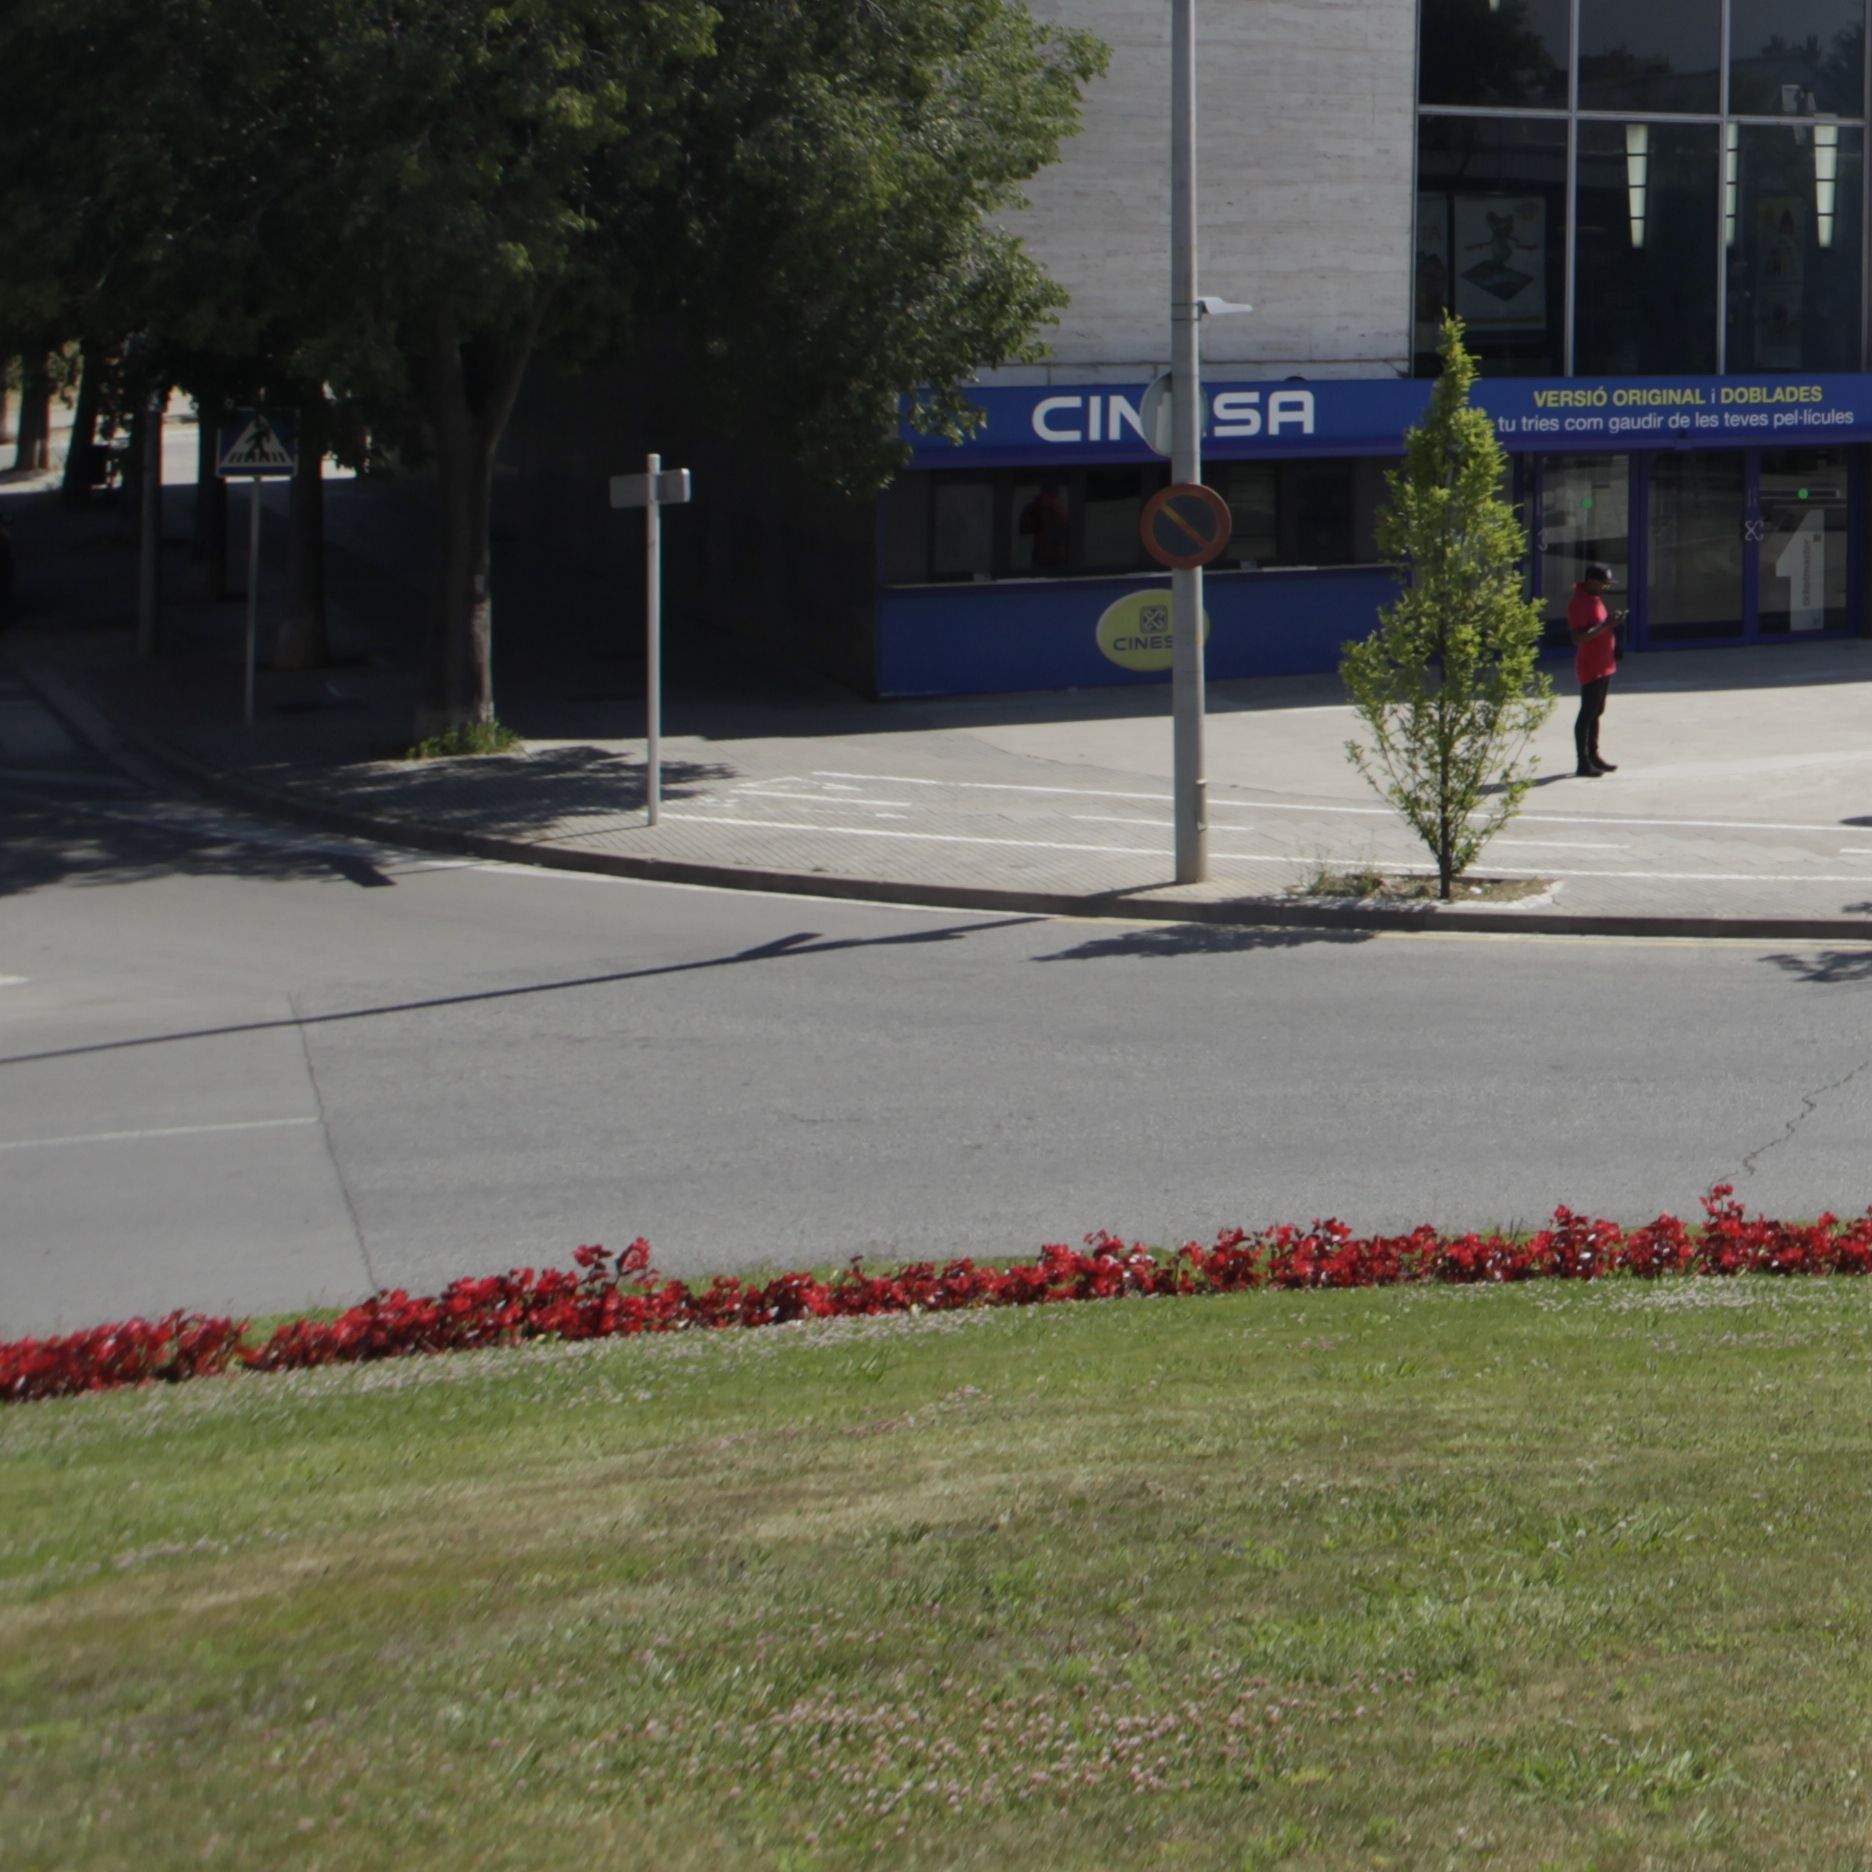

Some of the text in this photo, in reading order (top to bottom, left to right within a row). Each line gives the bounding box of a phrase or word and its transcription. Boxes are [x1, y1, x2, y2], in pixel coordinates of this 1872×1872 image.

[1534, 386, 1823, 408] VERSIÓ ORIGINAL i DOBLADES
[1032, 390, 1315, 442] CINSA
[1499, 416, 1516, 432] tu
[1521, 414, 1559, 432] tries
[1564, 417, 1603, 431] com
[1609, 412, 1663, 434] gaudir
[1668, 412, 1690, 428] de
[1695, 411, 1719, 428] les
[1724, 412, 1769, 428] teves
[1113, 635, 1173, 651] CINES
